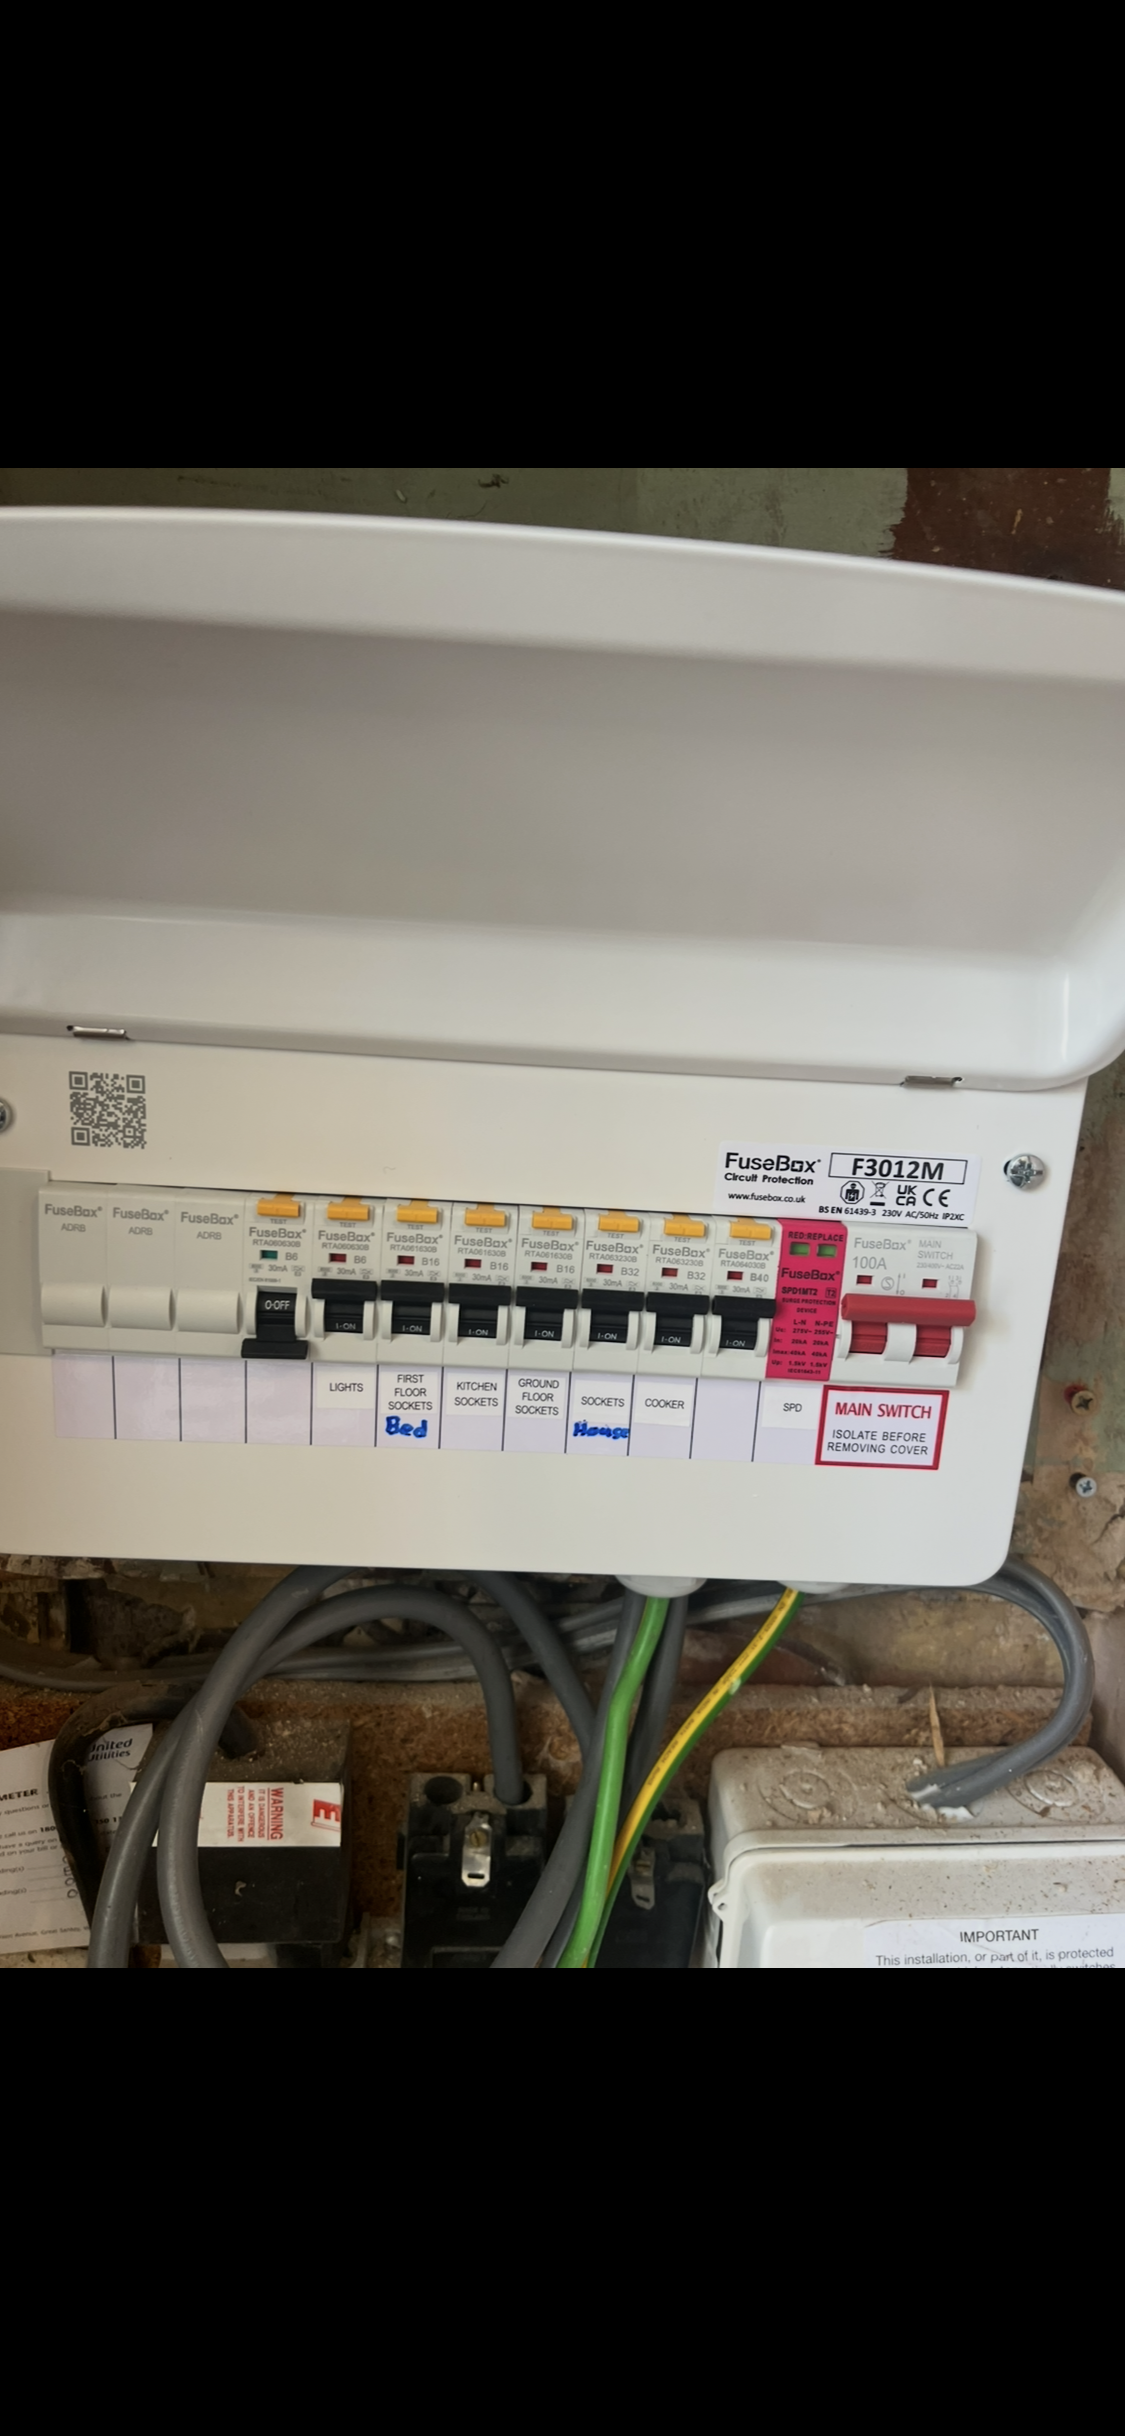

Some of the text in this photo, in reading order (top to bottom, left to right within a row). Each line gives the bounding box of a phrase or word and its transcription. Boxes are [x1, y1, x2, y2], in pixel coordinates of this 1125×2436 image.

[725, 1152, 816, 1173] FuseBox
[851, 1158, 945, 1181] F3012M
[724, 1172, 814, 1186] Circuit Protection
[728, 1192, 806, 1204] www.fusebox.co.uk
[44, 1203, 98, 1218] FuseBox
[112, 1207, 165, 1221] FuseBox
[818, 1206, 830, 1214] BS
[830, 1206, 843, 1214] EN
[844, 1207, 876, 1216] 61439-3
[905, 1211, 939, 1220] AC/50Hz
[942, 1212, 965, 1221] IP2XC
[180, 1211, 234, 1225] FuseBox
[60, 1223, 86, 1233] ADRB
[128, 1226, 153, 1236] ADRB
[249, 1227, 302, 1239] FuseBox
[196, 1231, 222, 1240] ADRB
[318, 1230, 371, 1242] FuseBox
[386, 1232, 439, 1244] FuseBox
[454, 1235, 508, 1248] FuseBox
[521, 1238, 575, 1251] FuseBox
[854, 1238, 906, 1250] FuseBox
[918, 1240, 942, 1248] MAIN
[586, 1241, 639, 1254] FuseBox
[652, 1244, 706, 1258] FuseBox
[285, 1252, 298, 1261] B6
[353, 1255, 367, 1264] B6
[718, 1248, 771, 1261] FuseBox
[918, 1250, 954, 1260] SWITCH
[421, 1257, 440, 1266] B16
[490, 1261, 509, 1271] B16
[852, 1256, 887, 1270] 100A
[268, 1264, 288, 1272] 30mA
[337, 1267, 356, 1275] 30mA
[404, 1269, 424, 1277] 30mA
[556, 1264, 575, 1274] B16
[621, 1267, 640, 1277] B32
[472, 1273, 492, 1281] 30mA
[538, 1276, 558, 1284] 30mA
[687, 1271, 706, 1280] B32
[750, 1272, 769, 1282] B40
[781, 1268, 836, 1281] FuseBox
[603, 1279, 622, 1287] 30mA
[669, 1282, 688, 1291] 30mA
[397, 1374, 424, 1384] FIRST
[518, 1378, 559, 1389] GROUND
[329, 1382, 364, 1392] LIGHTS
[394, 1388, 427, 1397] FLOOR
[456, 1382, 498, 1392] KITCHEN
[454, 1397, 498, 1408] SOCKETS
[522, 1392, 554, 1402] FLOOR
[581, 1396, 625, 1408] SOCKETS
[388, 1401, 432, 1411] SOCKETS
[644, 1398, 684, 1410] COOKER
[783, 1403, 802, 1412] SPD
[515, 1405, 559, 1416] SOCKETS
[835, 1402, 932, 1419] MAIN SWITCH
[386, 1416, 428, 1438] Bed
[832, 1429, 926, 1442] ISOLATE BEFORE
[827, 1442, 928, 1456] REMOVING COVER
[271, 1787, 284, 1840] WARNING
[960, 1929, 1039, 1942] IMPORTANT
[876, 1948, 1114, 1966] This installation, or part of it, is protected
